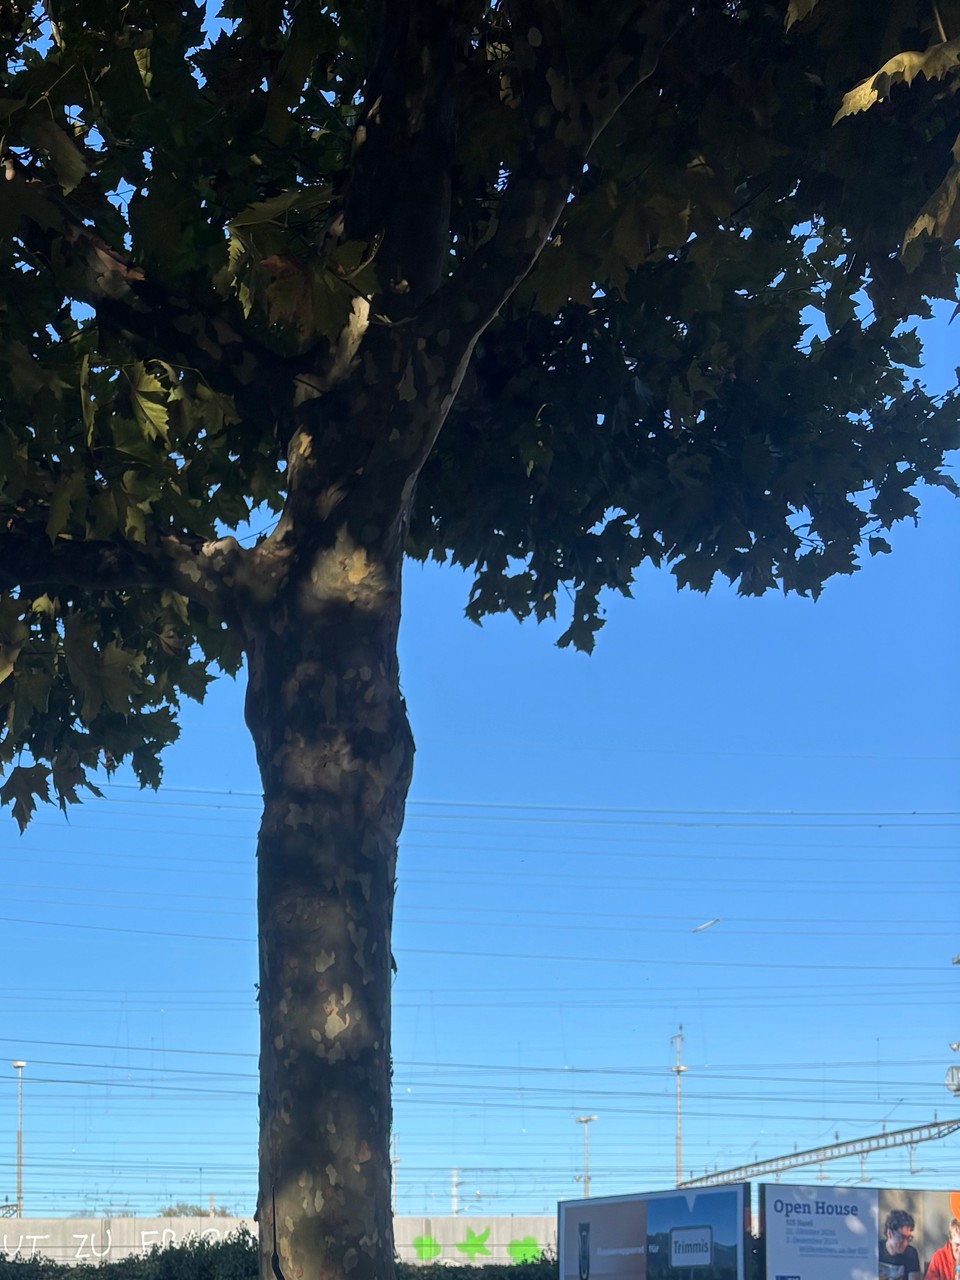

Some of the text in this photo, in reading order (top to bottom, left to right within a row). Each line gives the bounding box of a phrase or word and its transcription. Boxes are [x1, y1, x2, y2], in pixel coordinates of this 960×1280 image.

[773, 1199, 859, 1217] Open House
[72, 1229, 112, 1258] ZU
[674, 1239, 709, 1255] Trimmis
